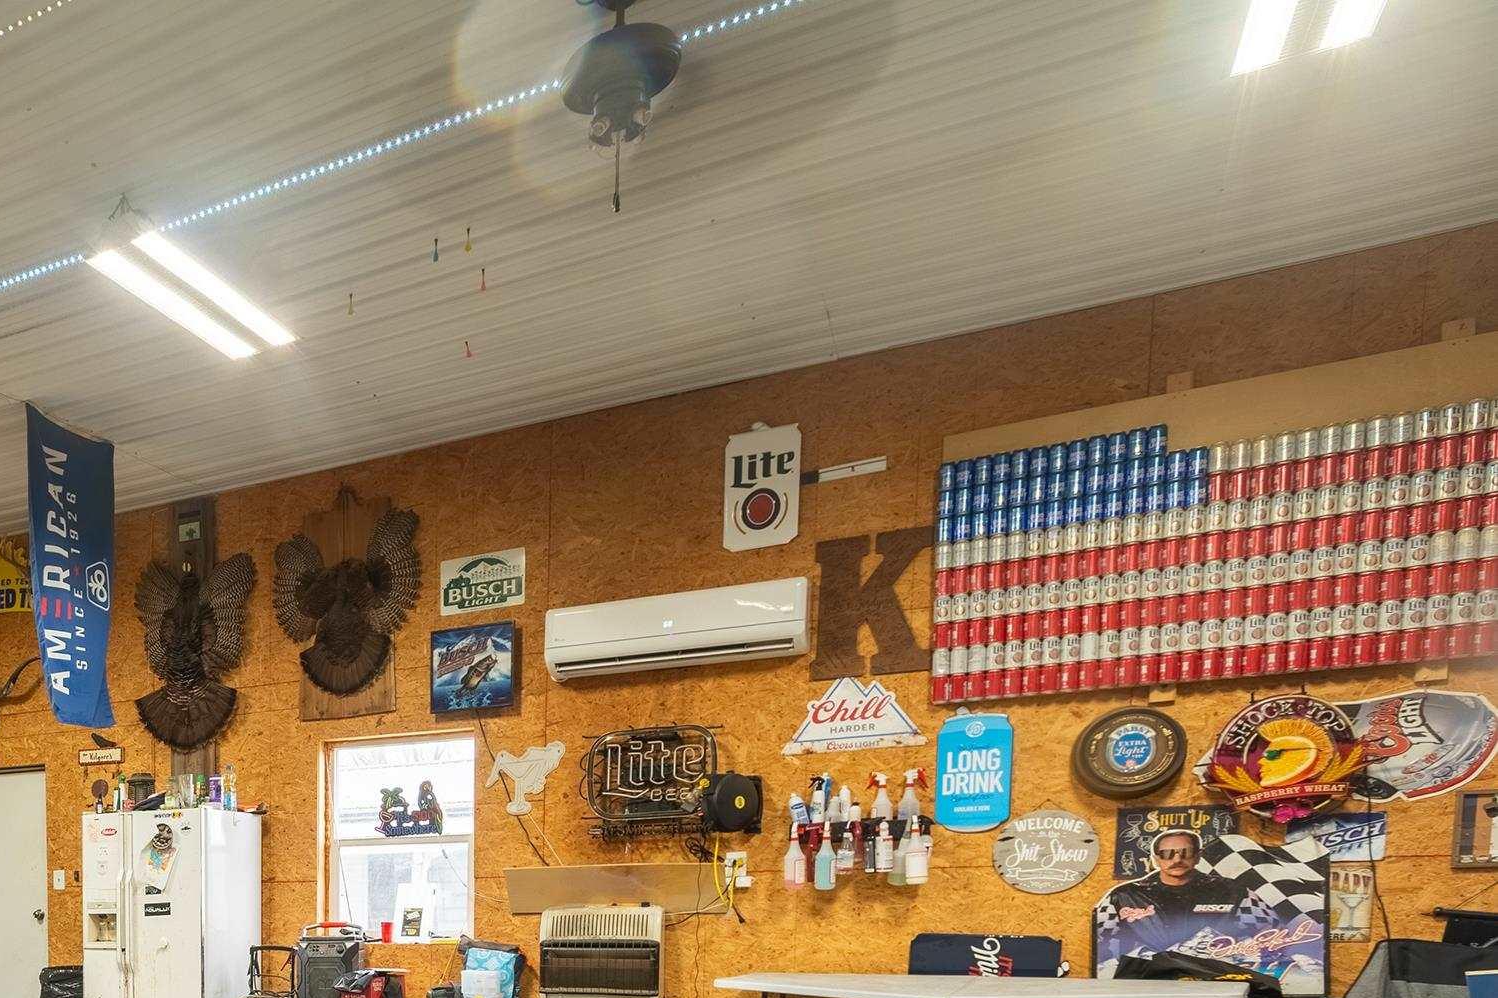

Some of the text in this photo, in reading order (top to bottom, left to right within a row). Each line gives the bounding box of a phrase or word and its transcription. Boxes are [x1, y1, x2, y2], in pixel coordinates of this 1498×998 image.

[731, 451, 795, 488] Lite
[40, 445, 72, 695] AMERICAN
[66, 491, 88, 671] SINCE 1926
[448, 579, 516, 604] BUSCH
[464, 596, 501, 608] LIGHT
[811, 695, 893, 724] Chill
[1399, 698, 1445, 744] LIGHT
[830, 723, 876, 734] HARDER
[1225, 700, 1346, 748] SHOCK TOP
[826, 739, 880, 750] Coors LIGHT
[1115, 746, 1147, 757] Light
[1118, 739, 1147, 747] EXTRA
[602, 741, 705, 798] Lite
[946, 748, 1001, 773] LONG
[650, 788, 692, 801] BEE
[942, 771, 1004, 795] DRINK
[1236, 784, 1346, 805] RASPBERRY WHEAT
[1014, 817, 1084, 833] WELCOME
[1143, 809, 1211, 832] SHUT UP
[1005, 838, 1089, 869] Shit Show
[1192, 904, 1234, 912] BUSCH
